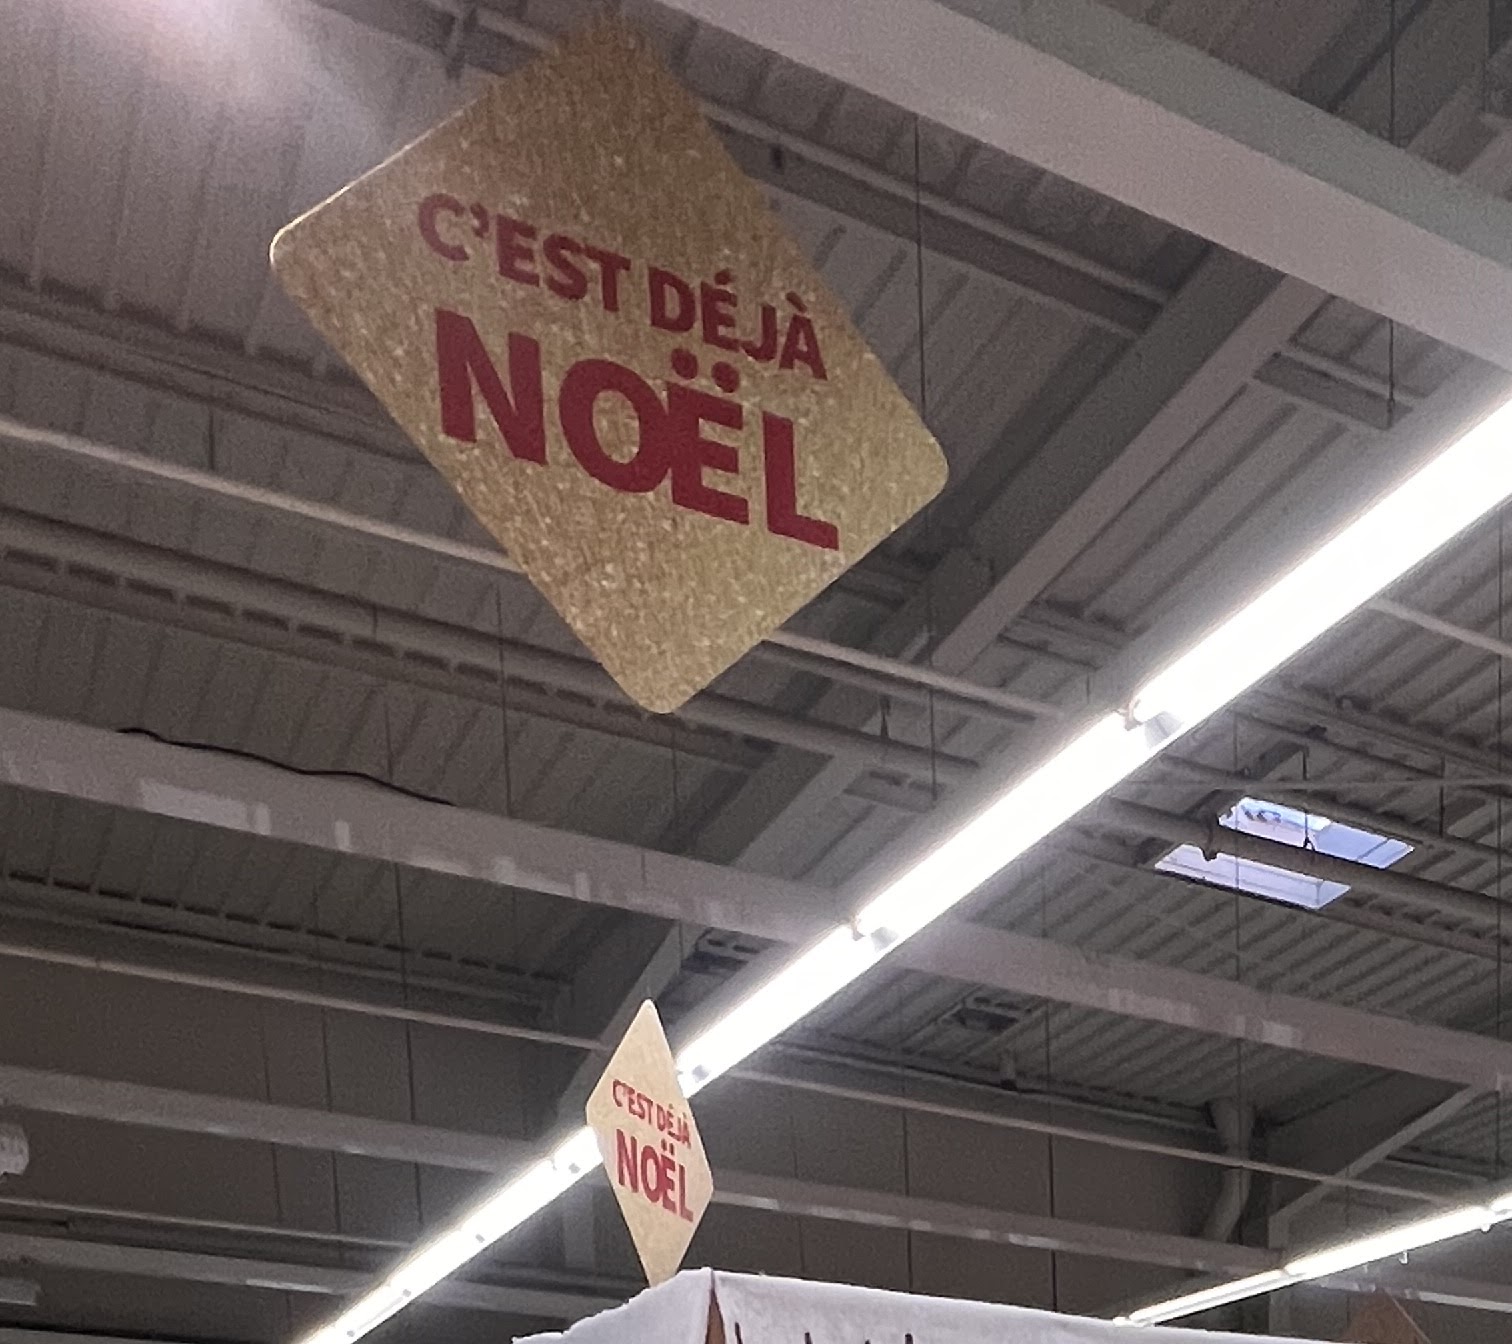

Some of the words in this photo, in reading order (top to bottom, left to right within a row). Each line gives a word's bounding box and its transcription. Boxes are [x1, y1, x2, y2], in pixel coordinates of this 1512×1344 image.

[417, 192, 631, 313] C'EST
[649, 269, 828, 381] DÉJÀ
[434, 307, 840, 551] NOËL
[612, 1079, 653, 1125] C'EST
[656, 1103, 692, 1149] DÉJÀ
[616, 1129, 693, 1222] NOËL
